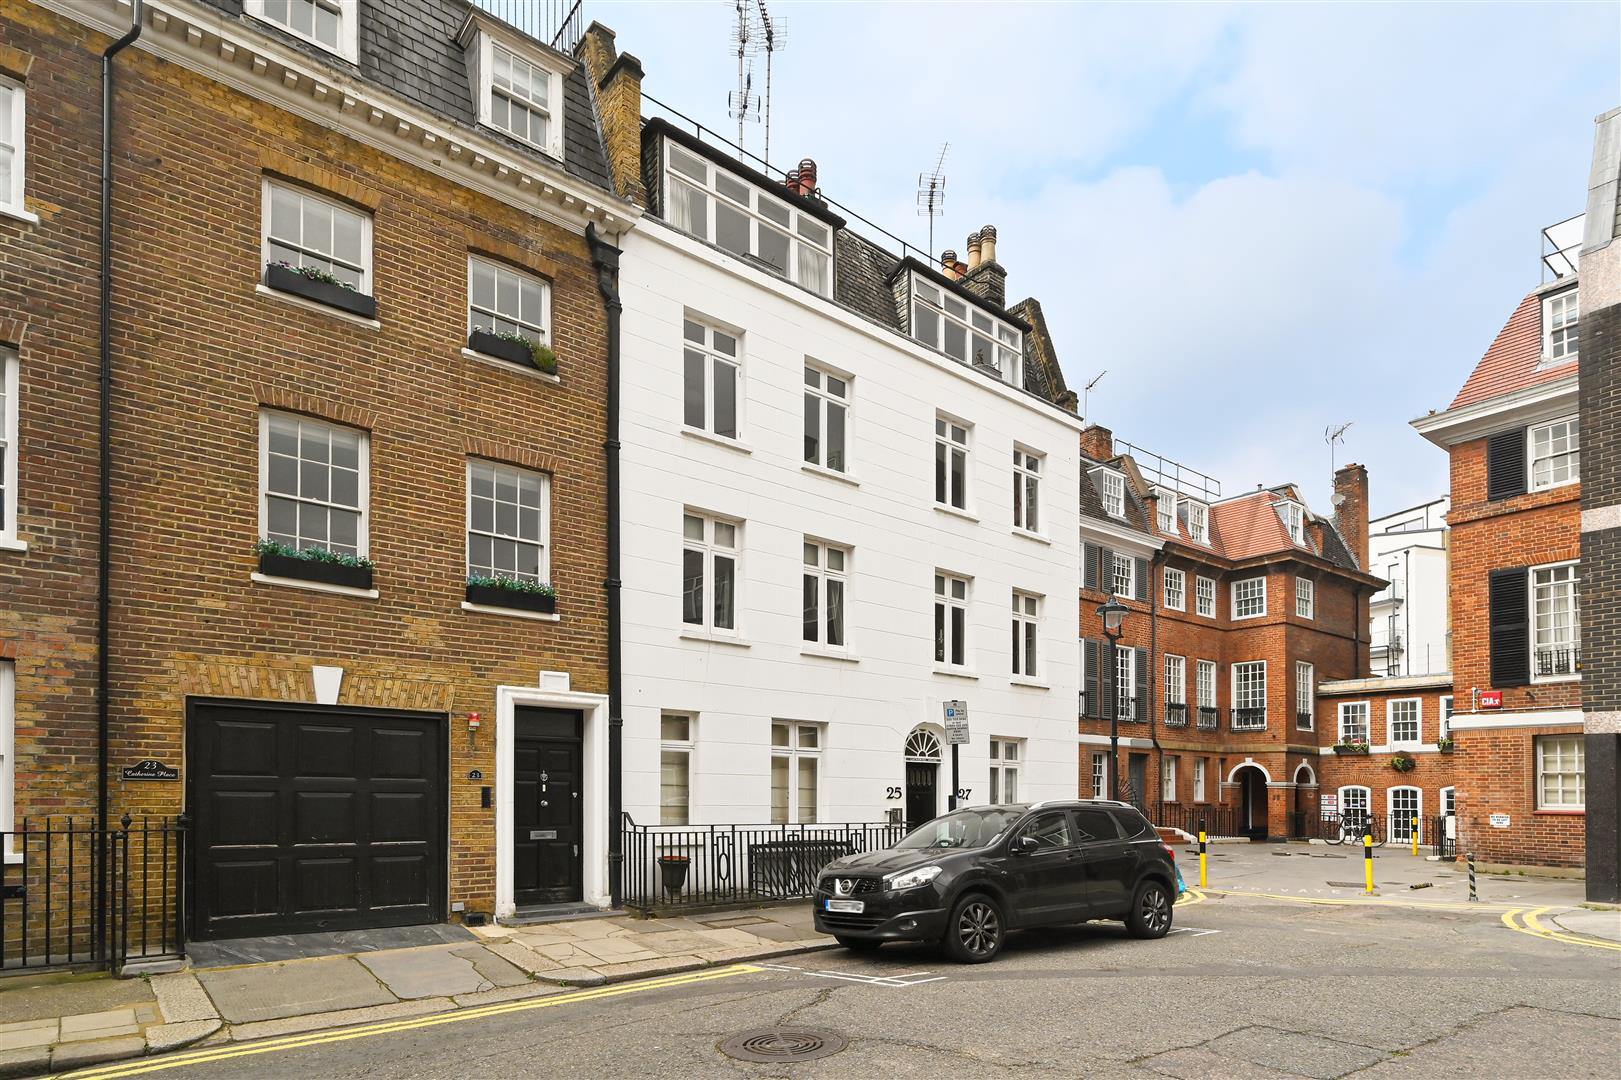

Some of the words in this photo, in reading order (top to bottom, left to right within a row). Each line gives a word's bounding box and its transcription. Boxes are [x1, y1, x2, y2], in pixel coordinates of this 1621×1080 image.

[144, 761, 157, 770] 23
[886, 786, 903, 800] 25
[958, 788, 972, 801] 27
